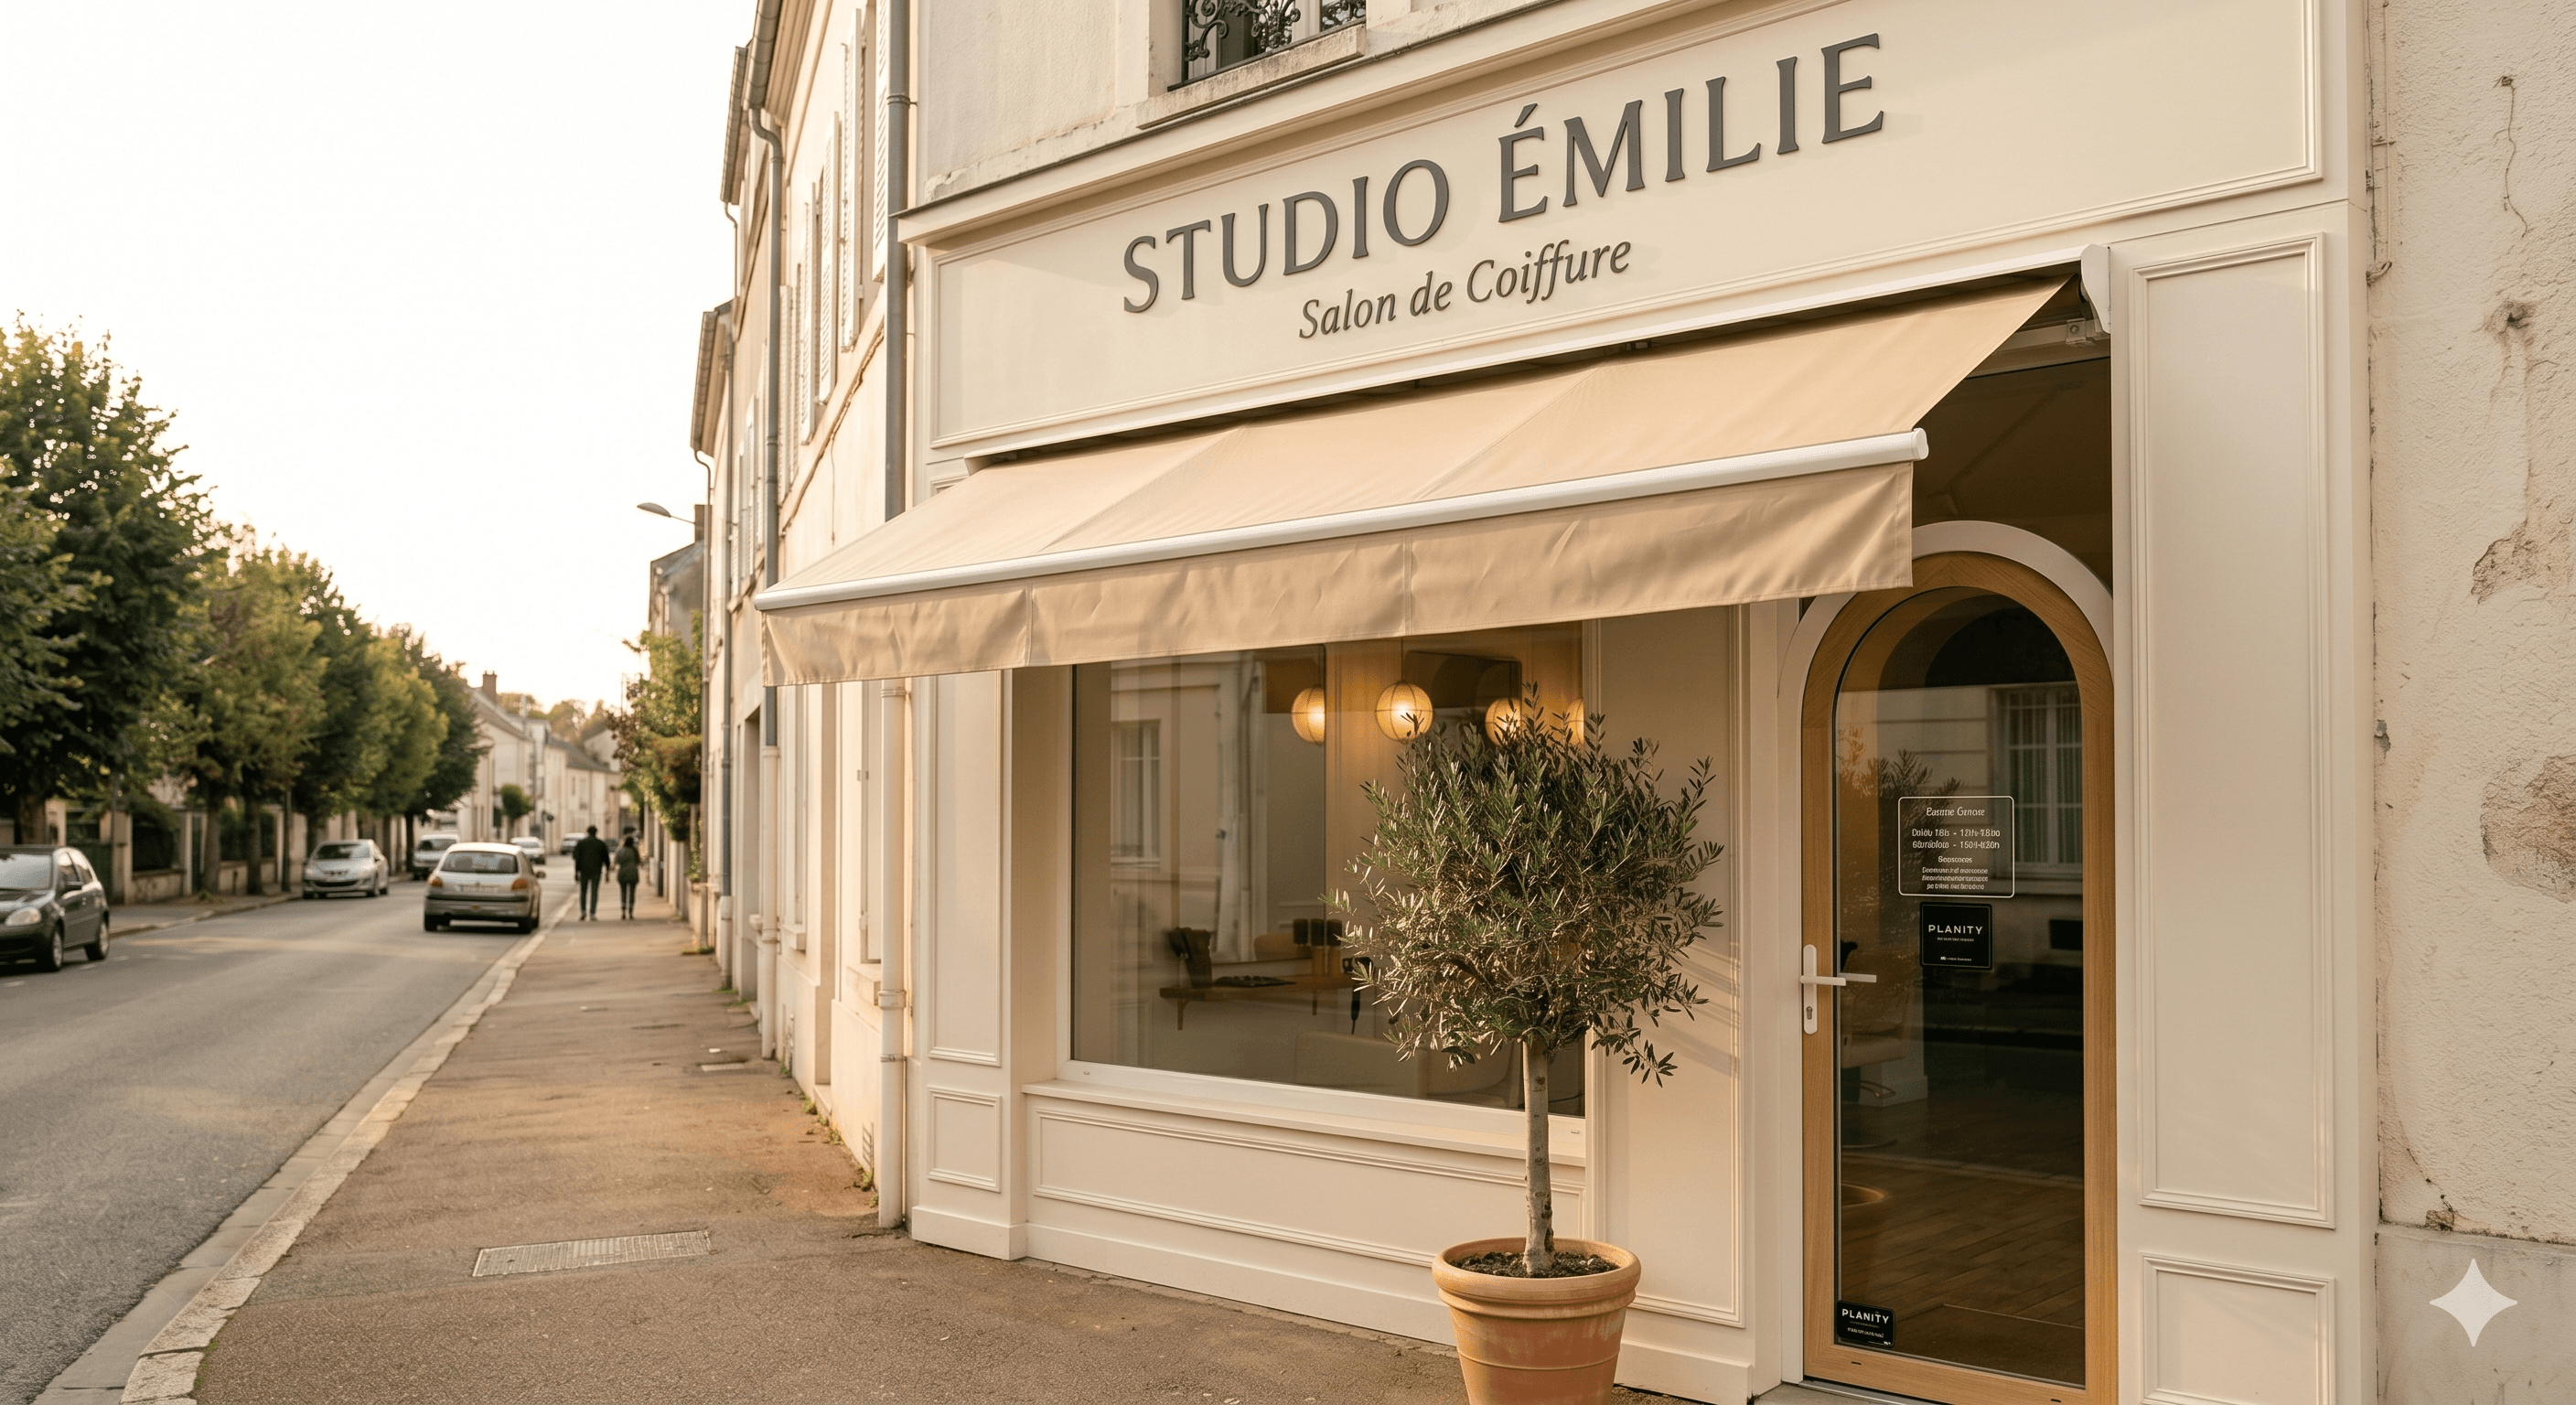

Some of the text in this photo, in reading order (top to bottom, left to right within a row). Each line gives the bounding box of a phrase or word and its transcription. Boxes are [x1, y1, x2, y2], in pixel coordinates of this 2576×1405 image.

[1123, 32, 1884, 314] STUDIO ÉMILIE
[1298, 239, 1632, 340] Salon de Coiffure
[1927, 924, 1983, 935] PLANITY
[1841, 1308, 1889, 1324] PLANITY
